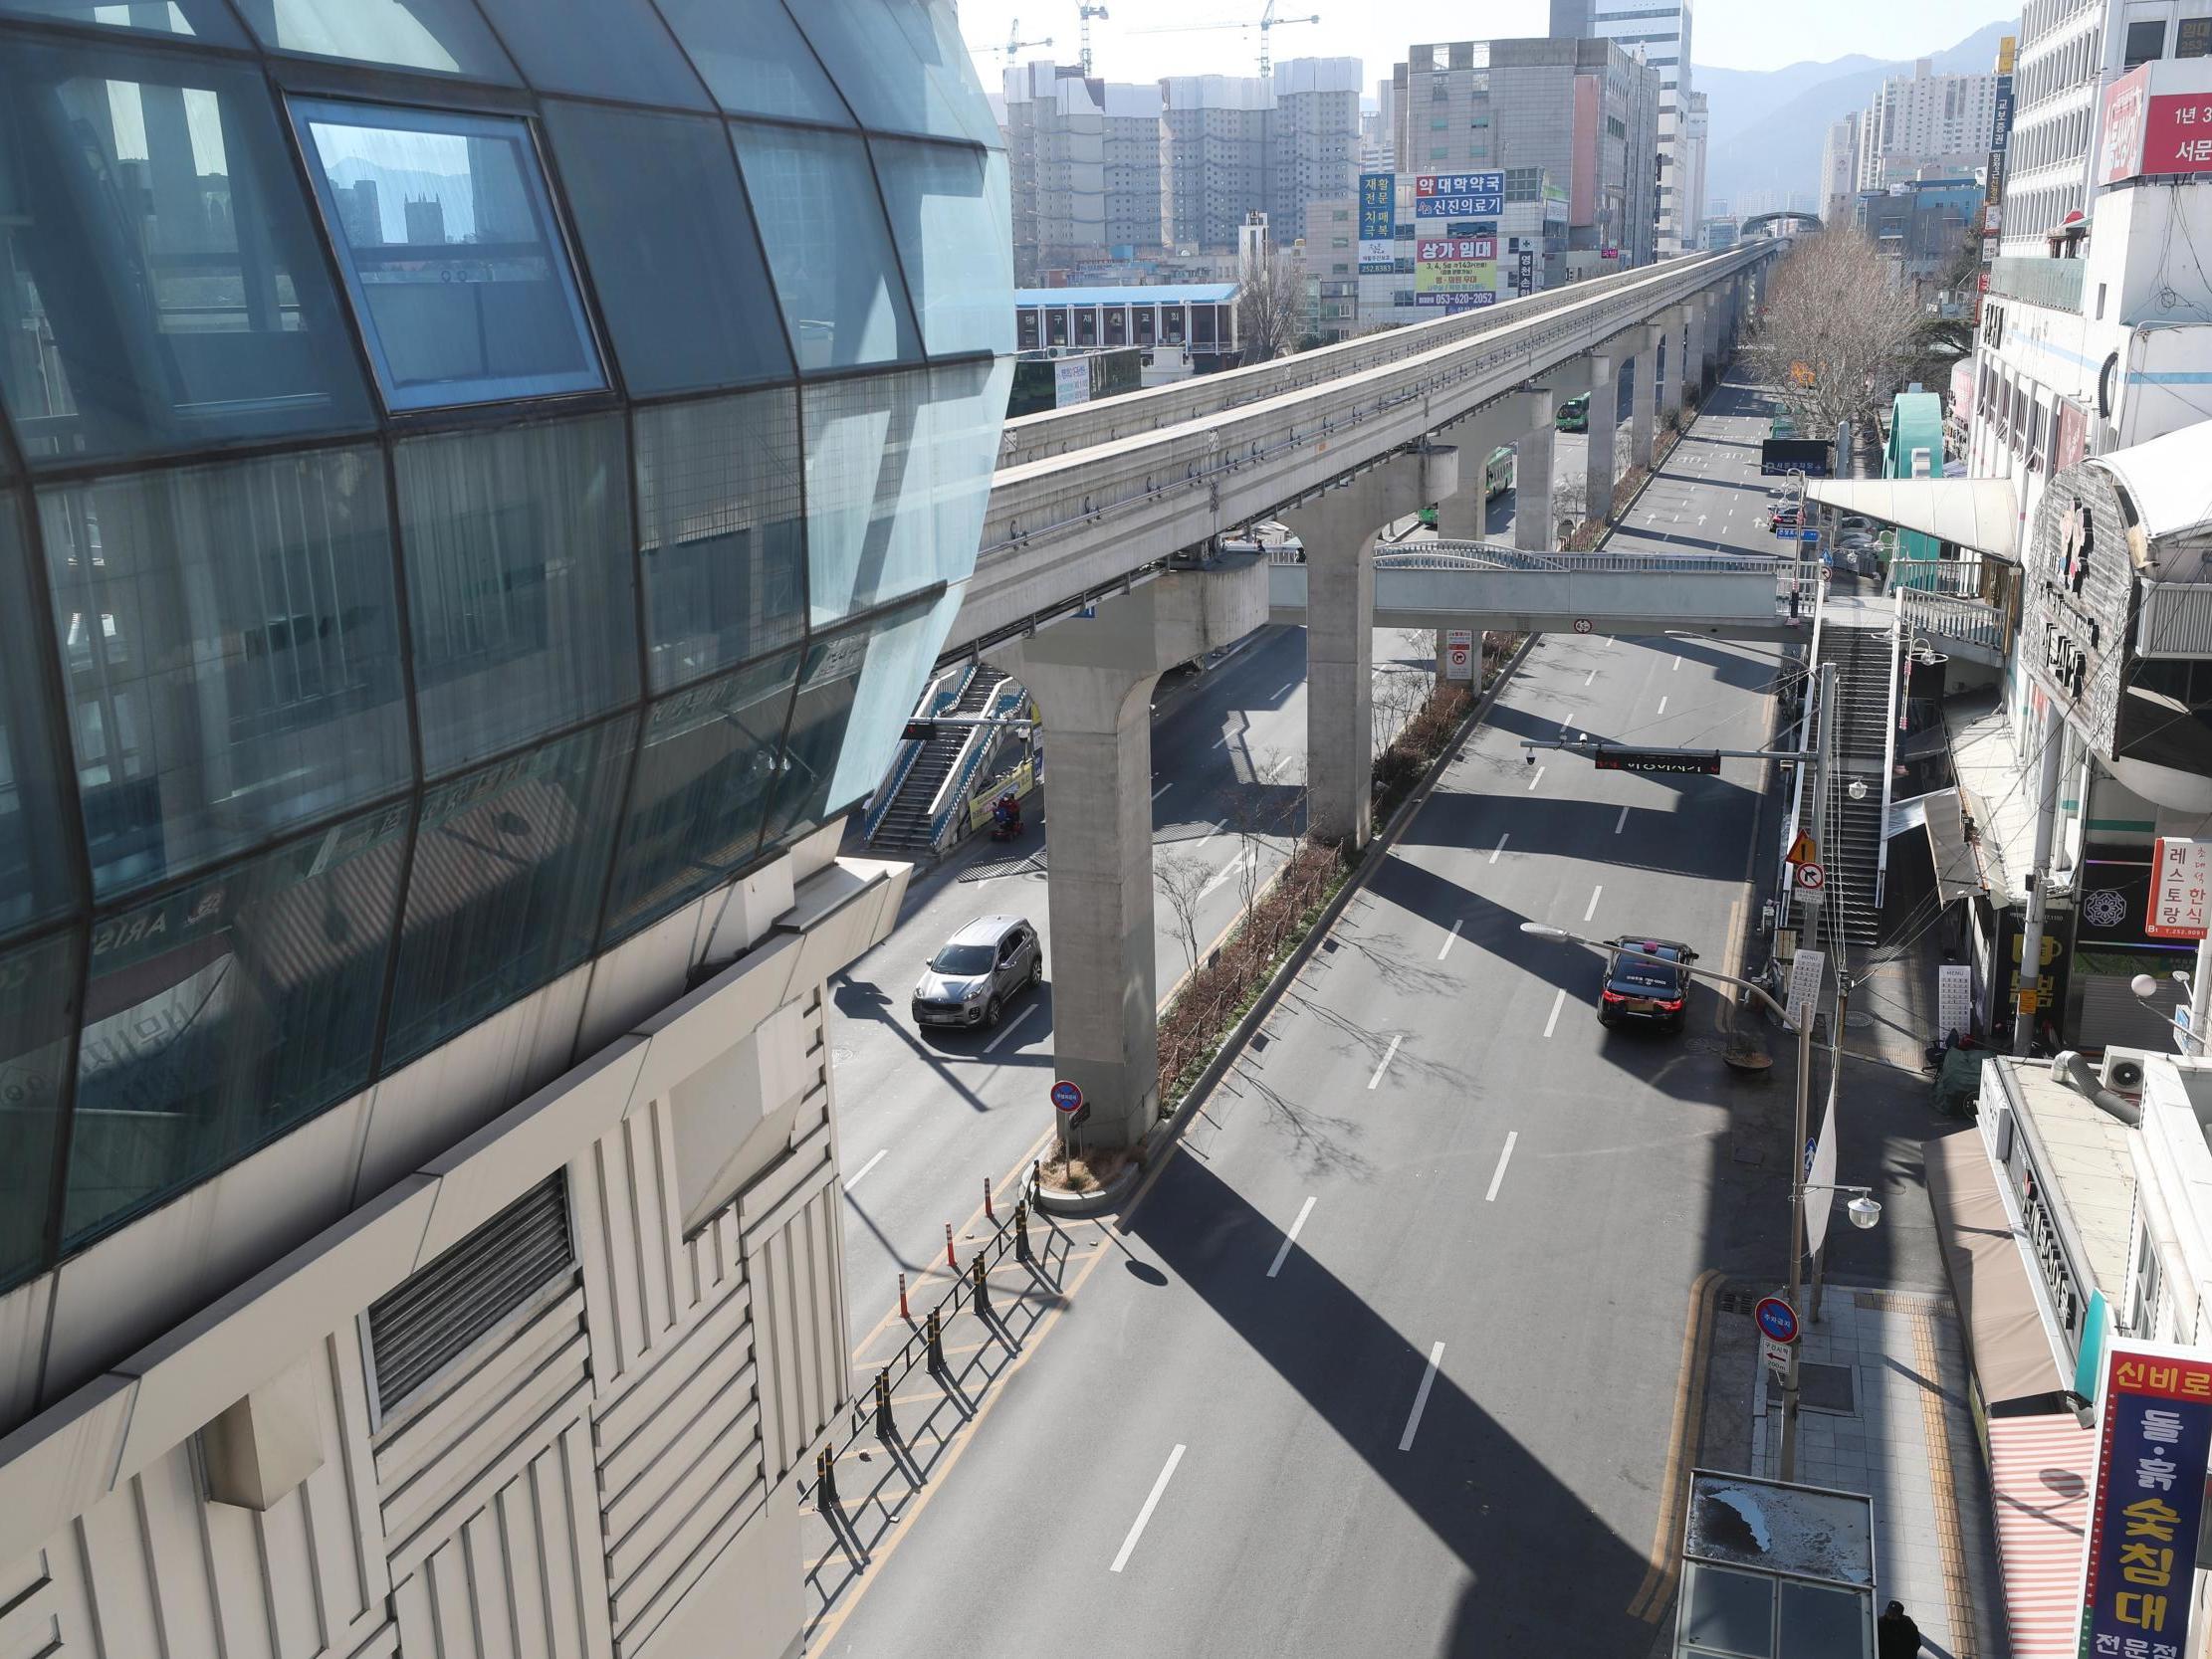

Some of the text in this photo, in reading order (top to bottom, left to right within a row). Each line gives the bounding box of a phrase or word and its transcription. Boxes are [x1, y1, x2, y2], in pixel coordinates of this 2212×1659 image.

[2174, 105, 2196, 124] 1년
[1419, 176, 1500, 194] 약 대학약국
[1434, 197, 1500, 215] 신진의료기
[1422, 241, 1491, 259] 상가 임대
[1436, 293, 1492, 304] 053-620-2052
[2163, 847, 2187, 925] 레스토랑
[2186, 888, 2206, 925] 한식
[1764, 1313, 1791, 1329] 주차금지
[1767, 1359, 1786, 1371] 200m
[2116, 1360, 2212, 1396] 신비로
[2114, 1498, 2182, 1632] 숯침대
[2096, 1632, 2178, 1659] 전문점
